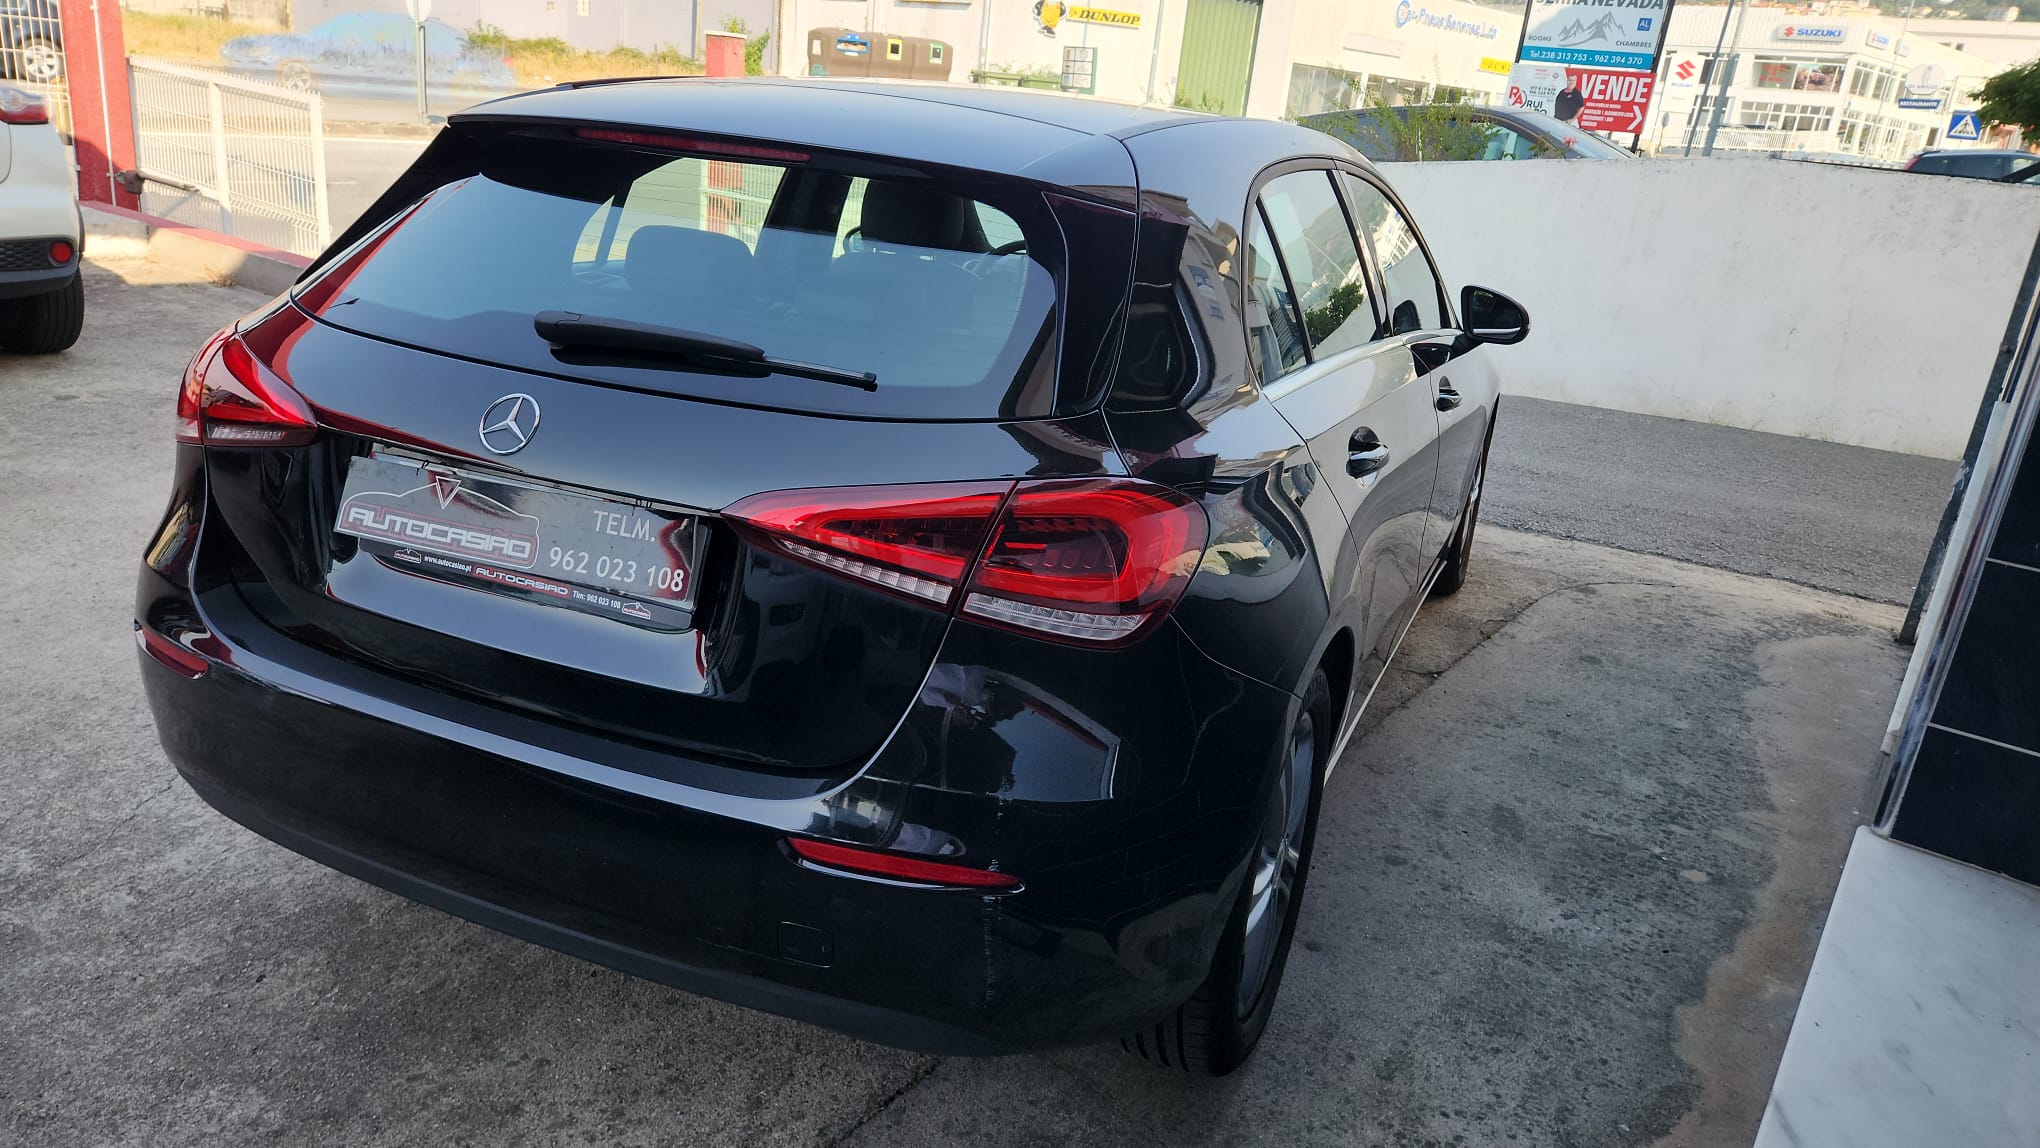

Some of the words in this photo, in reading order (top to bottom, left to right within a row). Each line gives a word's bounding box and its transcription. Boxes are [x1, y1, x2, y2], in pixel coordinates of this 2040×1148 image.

[1080, 10, 1140, 24] DUNLOP
[1797, 28, 1842, 37] SUZUKI
[1615, 40, 1652, 48] CHAMBRES
[1556, 52, 1571, 60] 313
[1572, 53, 1588, 62] 753
[1594, 54, 1609, 63] 962
[1610, 55, 1626, 64] 394
[1627, 56, 1643, 65] 370
[1581, 73, 1652, 103] VENDE
[1526, 100, 1543, 109] RUI
[593, 510, 656, 543] TELM.
[550, 547, 589, 574] 962
[596, 556, 637, 583] 023
[647, 565, 684, 592] 108
